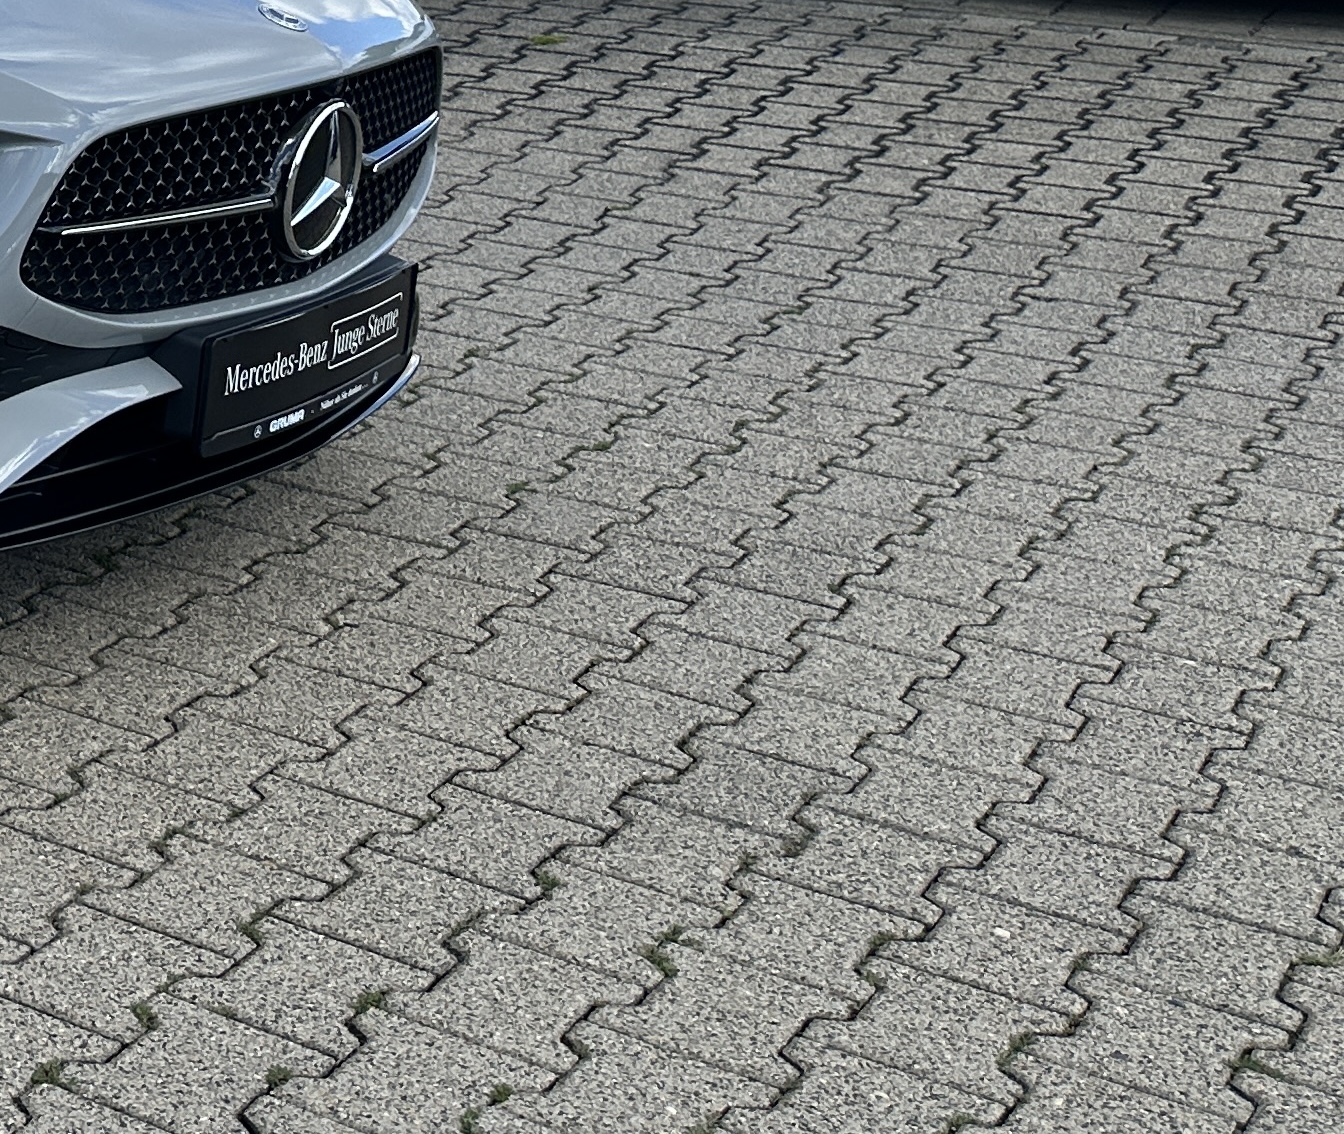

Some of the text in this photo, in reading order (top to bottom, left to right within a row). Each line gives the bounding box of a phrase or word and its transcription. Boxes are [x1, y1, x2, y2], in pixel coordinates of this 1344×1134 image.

[224, 308, 399, 396] Mercedes-Benz Junge Sterne
